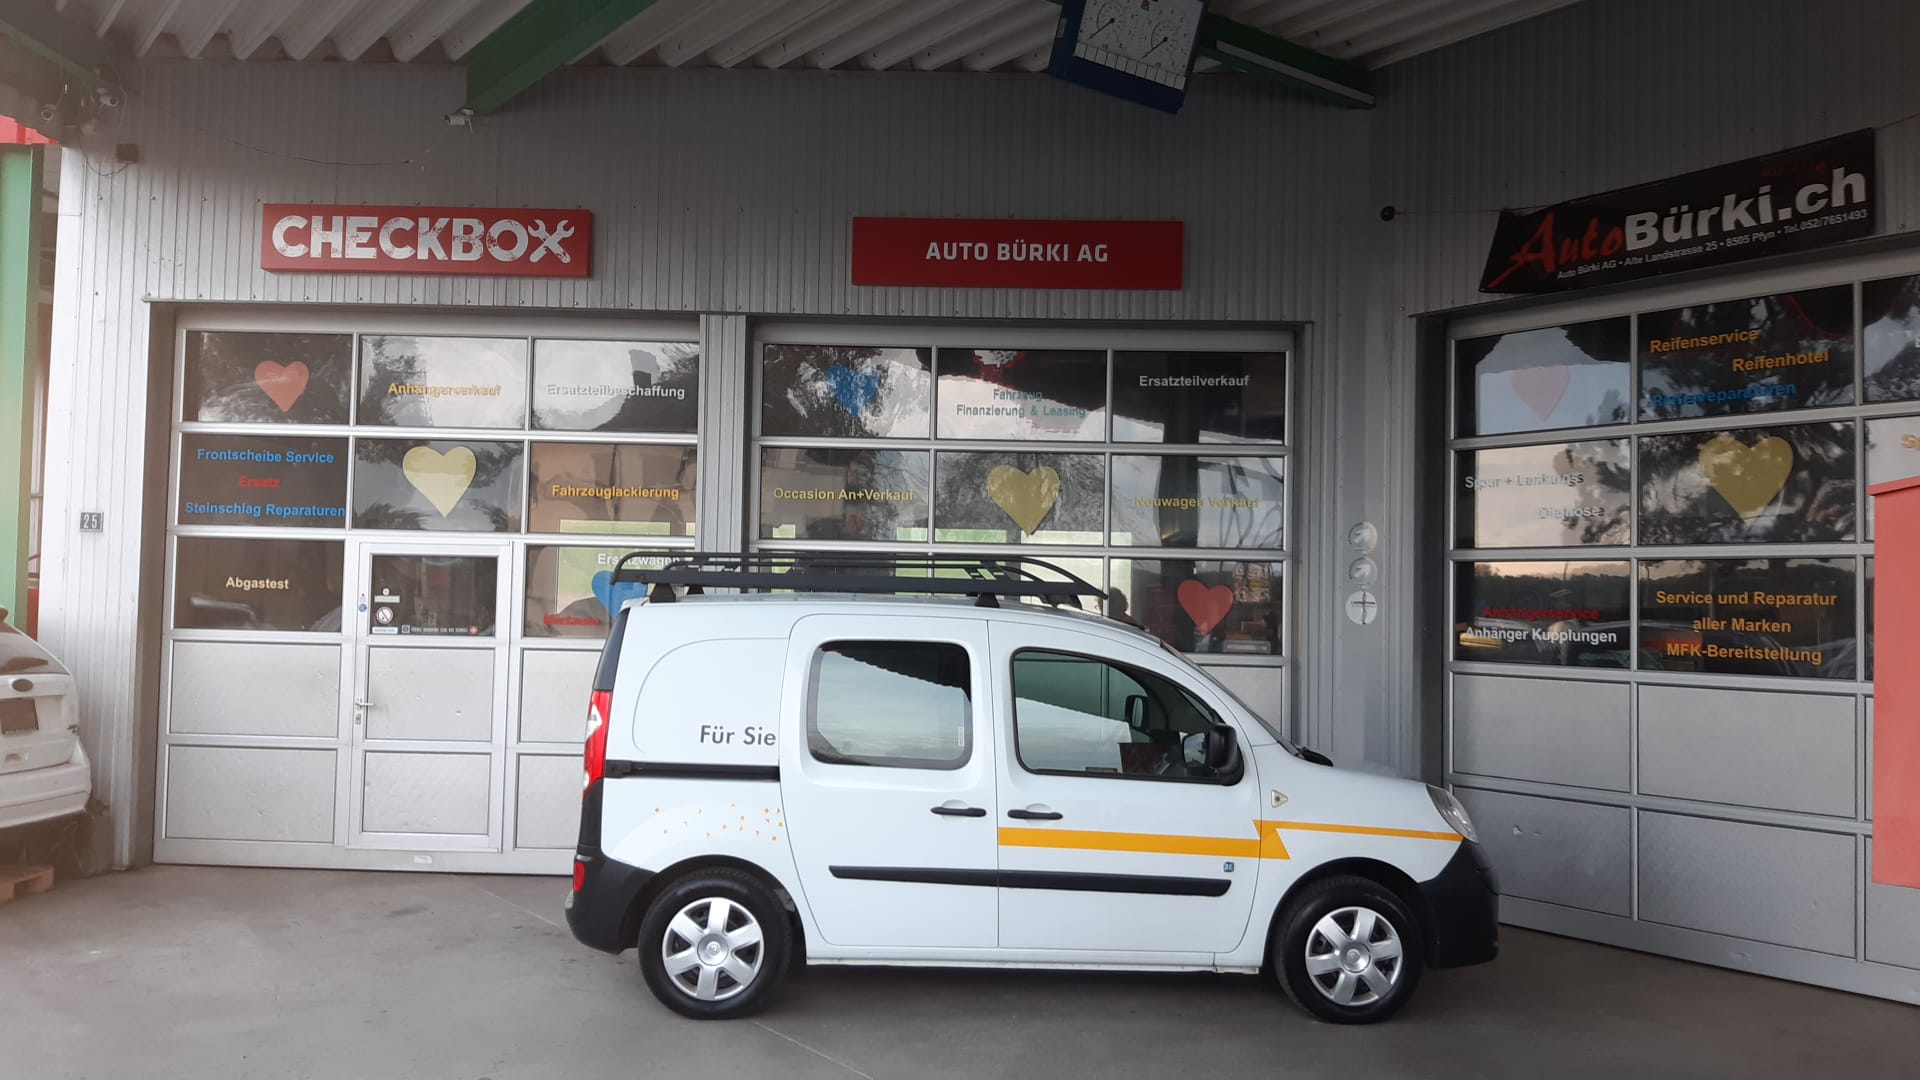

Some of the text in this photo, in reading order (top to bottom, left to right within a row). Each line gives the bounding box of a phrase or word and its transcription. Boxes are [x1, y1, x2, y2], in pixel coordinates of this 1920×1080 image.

[272, 215, 575, 263] CHECKBOX
[925, 239, 1108, 263] AUTO BÜRKI AG
[1556, 269, 1576, 280] Auto
[1601, 259, 1617, 270] AG
[1624, 256, 1643, 267] Alte
[1645, 245, 1704, 263] Landstrasse
[1705, 241, 1718, 252] 25
[1650, 328, 1761, 353] Reifenservice
[1731, 349, 1830, 372] Reifenhotel
[1139, 375, 1250, 387] Ersatzteilverkauf
[388, 382, 502, 399] Anhängerverkauf
[547, 384, 686, 400] Ersatzteilbeschaffung
[993, 388, 1043, 402] Fahrzeug
[956, 404, 1086, 419] Finanzierung & Leasing
[197, 448, 334, 463] Frontscheibe Service
[239, 475, 280, 488] Ersatz
[1465, 476, 1500, 491] Spur
[1516, 473, 1585, 487] Lenkungs
[552, 484, 680, 500] Fahrzeuglackierung
[773, 487, 914, 501] Occasion An+Verkauf
[185, 502, 347, 518] Steinschlag Reparaturen
[1135, 496, 1203, 510] Neuwagen
[83, 513, 98, 529] 25
[1539, 506, 1605, 522] Diagnose
[597, 553, 680, 568] Erstzwagen
[225, 576, 289, 591] Abgastest
[1656, 591, 1838, 608] Service und Reparatur
[1484, 607, 1601, 622] Anhängerservice
[1693, 617, 1792, 633] aller Marken
[1465, 626, 1617, 645] Anhänger Kupplungen
[1666, 643, 1823, 665] MFK-Bereitstellung
[700, 725, 776, 746] Für Sie
